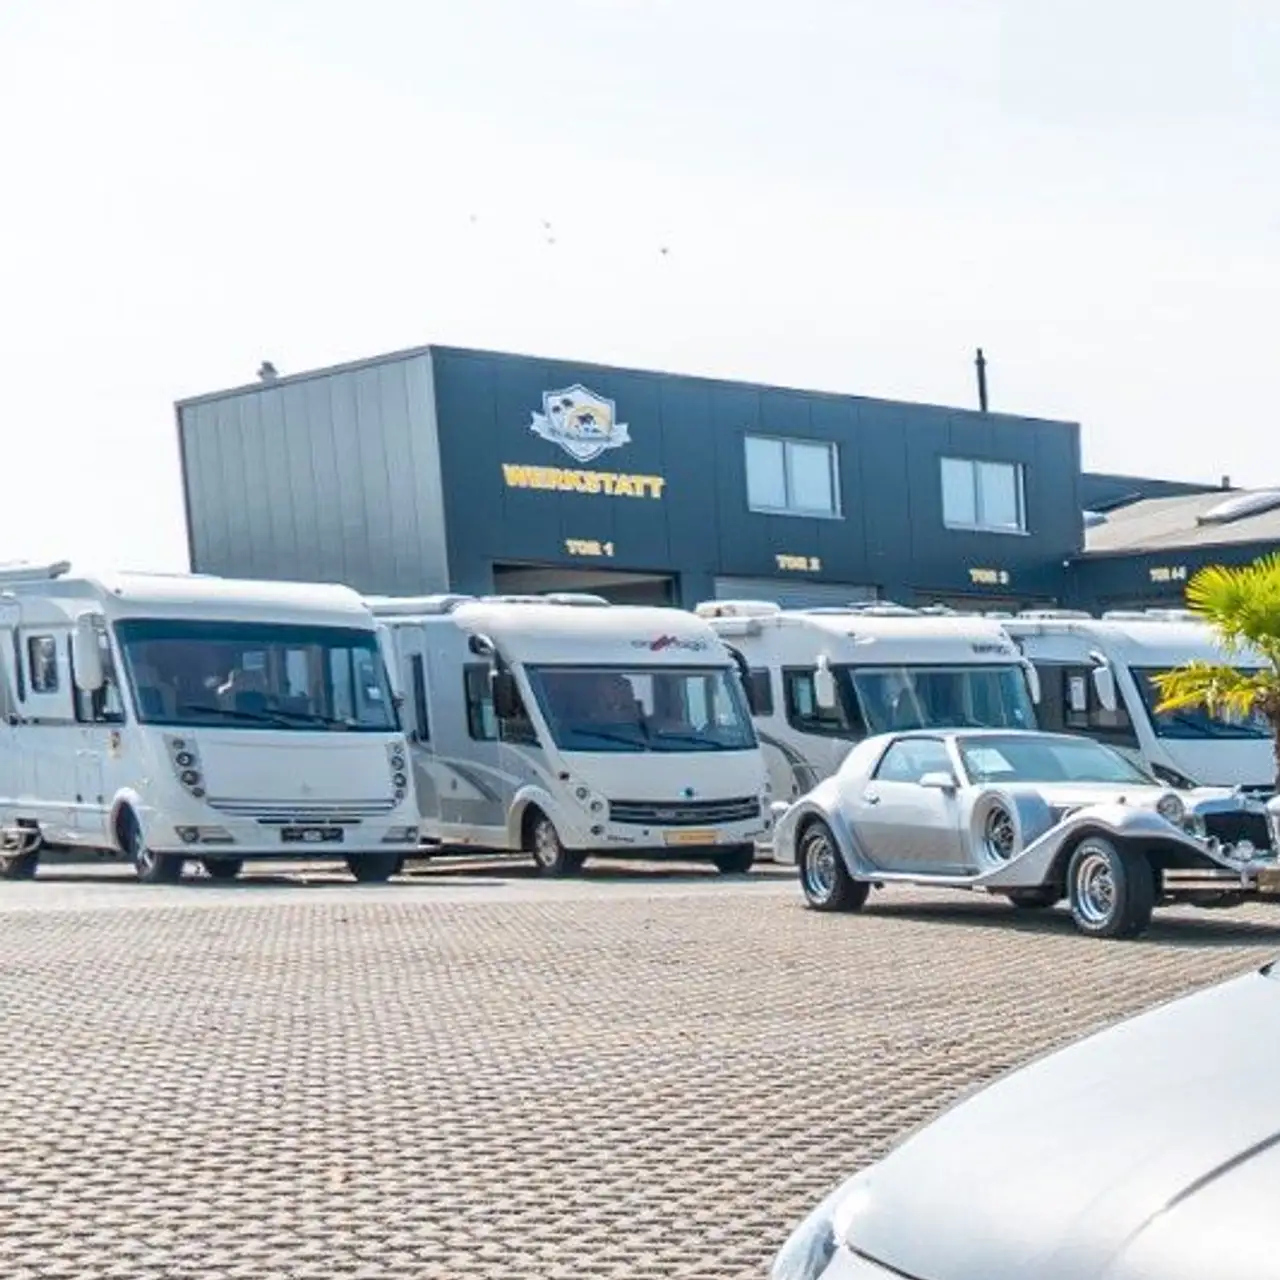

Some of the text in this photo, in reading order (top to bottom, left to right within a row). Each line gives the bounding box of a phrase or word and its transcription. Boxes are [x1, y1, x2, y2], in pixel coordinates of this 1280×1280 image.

[502, 463, 665, 499] WERKSTATT
[565, 539, 616, 557] TOR 1
[775, 554, 807, 571] TOR
[968, 567, 997, 584] TOR
